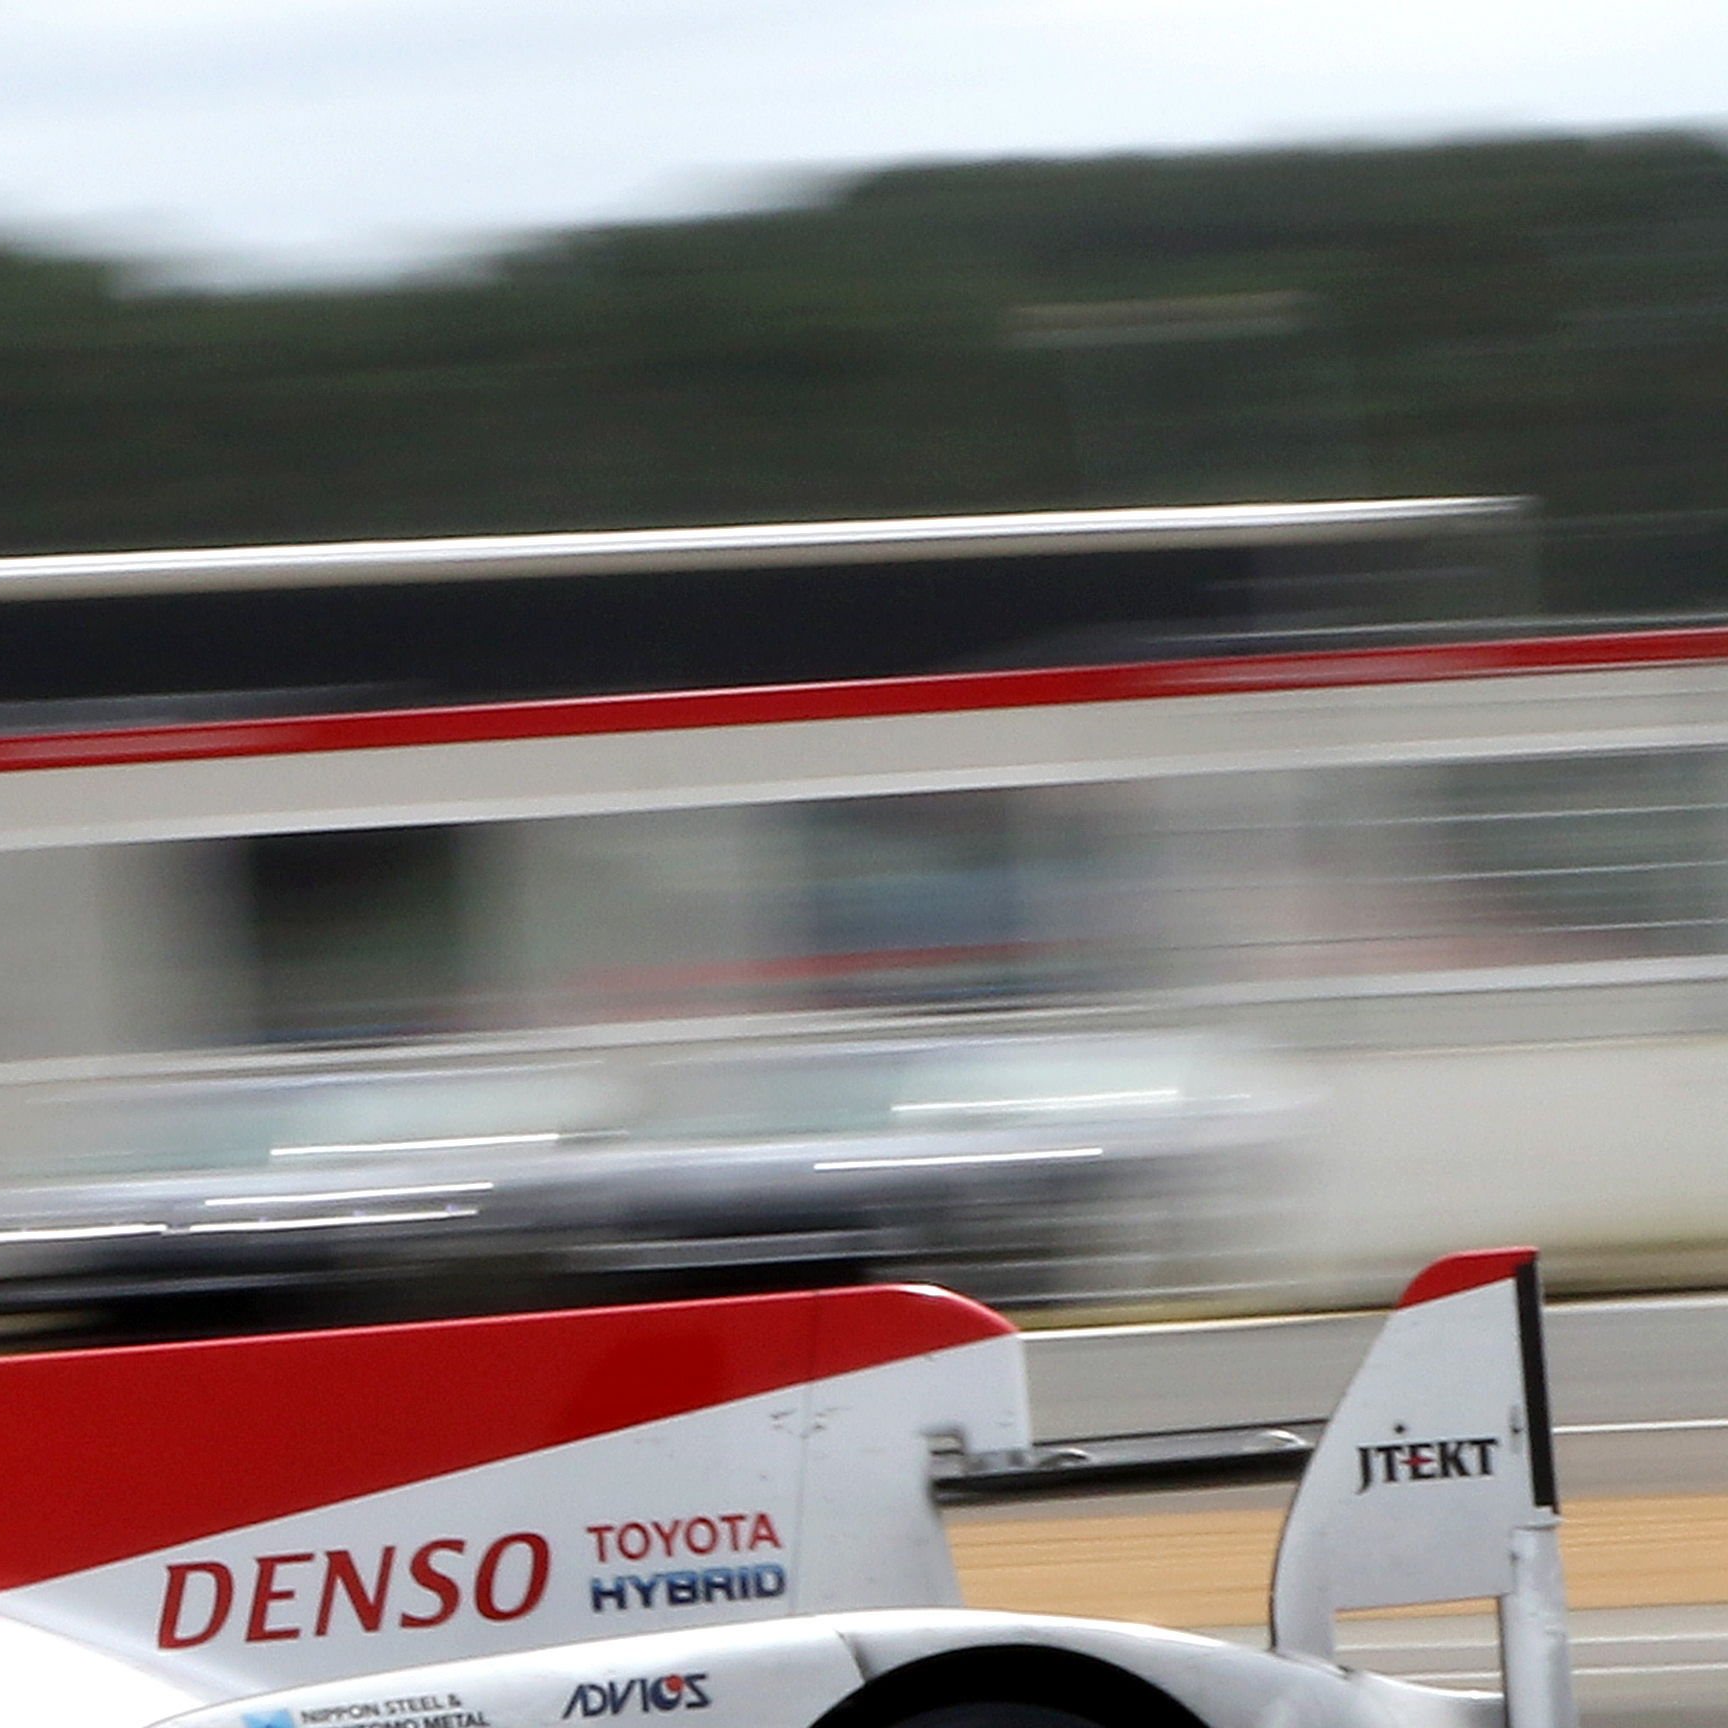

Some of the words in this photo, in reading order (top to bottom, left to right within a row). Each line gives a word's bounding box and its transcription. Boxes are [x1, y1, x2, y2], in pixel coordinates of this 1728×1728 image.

[1355, 1438, 1498, 1495] JTEKT
[586, 1513, 783, 1563] TOYOTA
[156, 1532, 551, 1651] DENSO
[591, 1563, 787, 1613] HYBRID
[301, 1704, 380, 1724] NIPPON
[384, 1695, 444, 1714] STEEL
[448, 1693, 463, 1708] &
[562, 1673, 712, 1719] ADVICS
